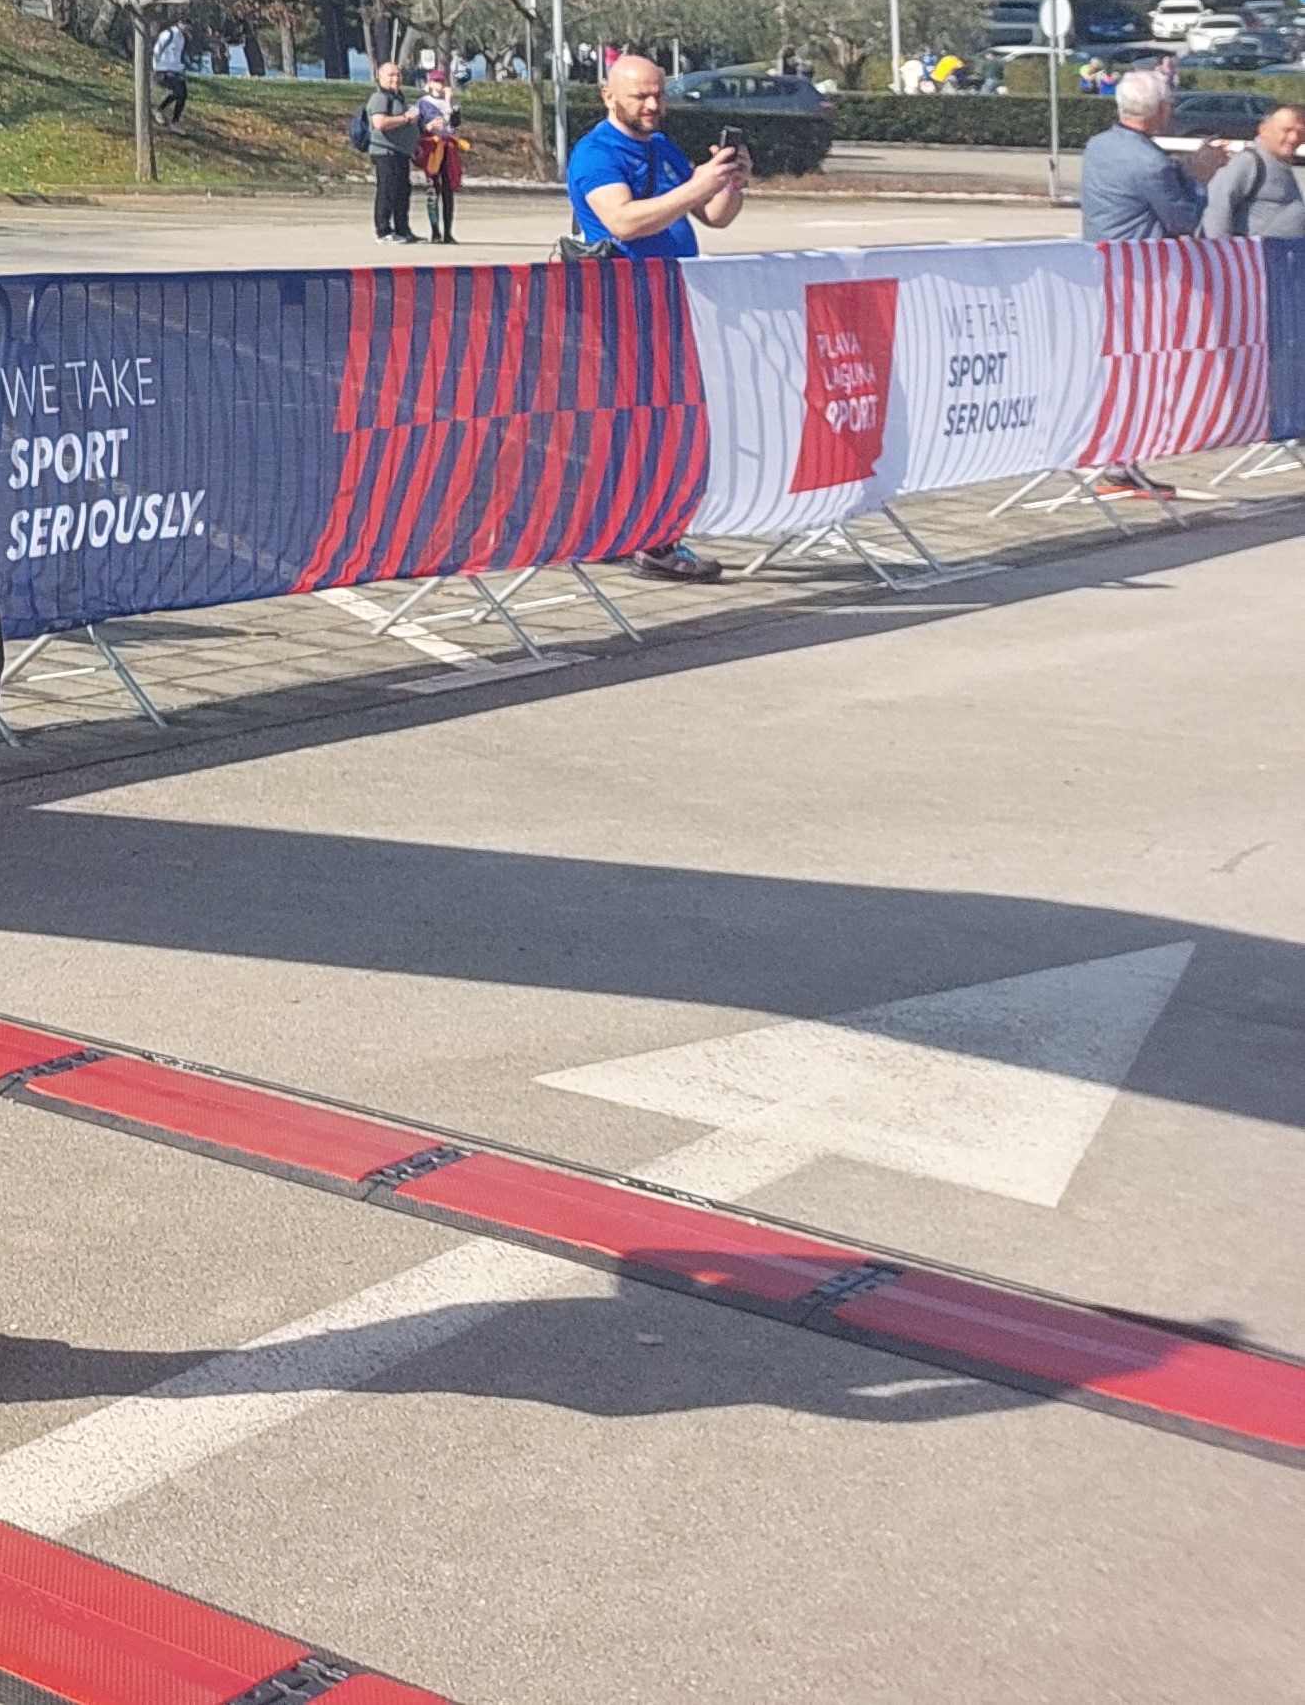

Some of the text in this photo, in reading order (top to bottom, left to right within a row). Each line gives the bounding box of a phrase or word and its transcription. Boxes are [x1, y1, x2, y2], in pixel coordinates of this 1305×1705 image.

[944, 300, 1019, 340] WE TAKE
[816, 331, 862, 360] PLAVA
[0, 357, 157, 418] WE TAKE
[948, 351, 1008, 388] SPORT
[825, 395, 878, 433] SPORT
[943, 395, 1038, 438] SERIOUSLY.
[8, 428, 129, 490] SPORT
[6, 489, 206, 562] SERIOUSLY.
